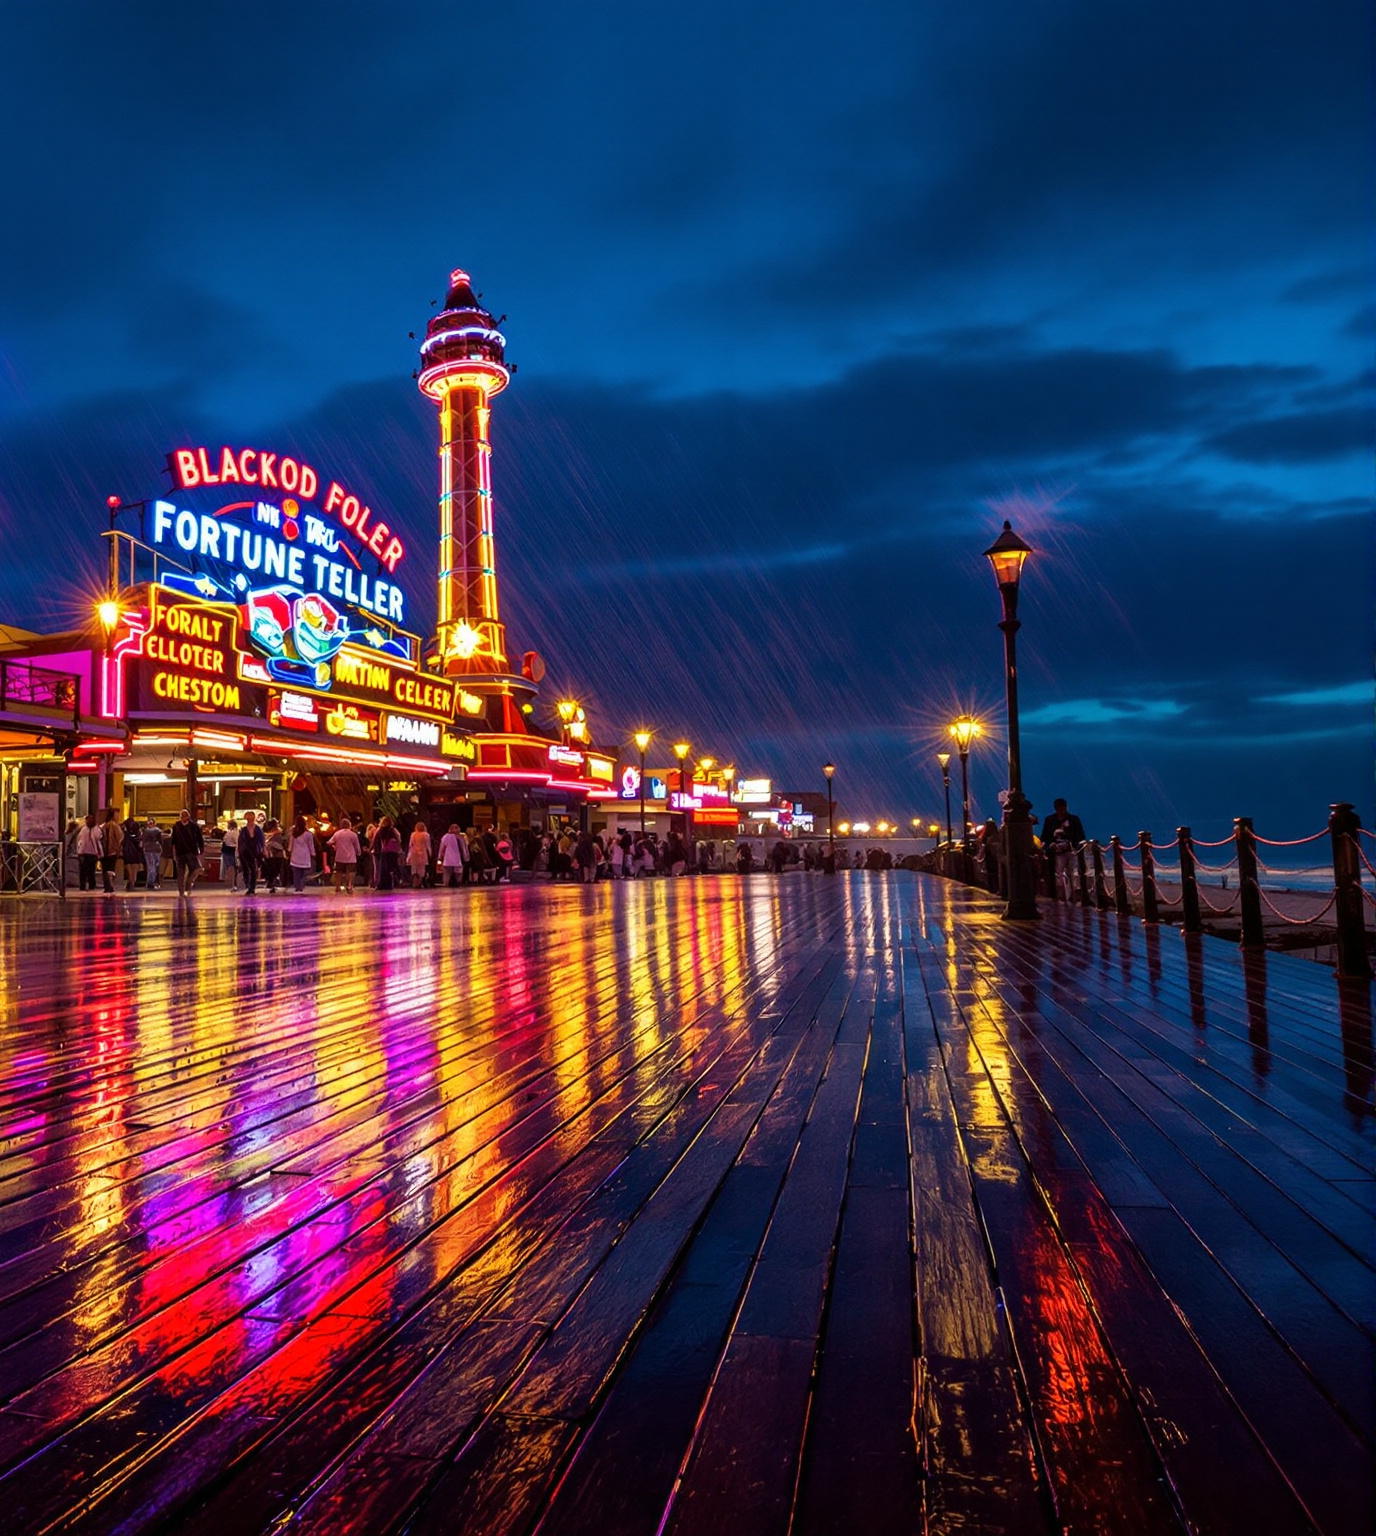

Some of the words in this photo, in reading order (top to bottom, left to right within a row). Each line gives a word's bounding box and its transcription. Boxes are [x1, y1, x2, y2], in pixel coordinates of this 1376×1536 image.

[176, 447, 318, 499] BLACKOD
[325, 481, 405, 573] FOLER
[154, 500, 306, 585] FORTUNE
[313, 553, 405, 623] TELLER
[156, 604, 223, 642] FORALT
[154, 672, 240, 709] CHESTOM
